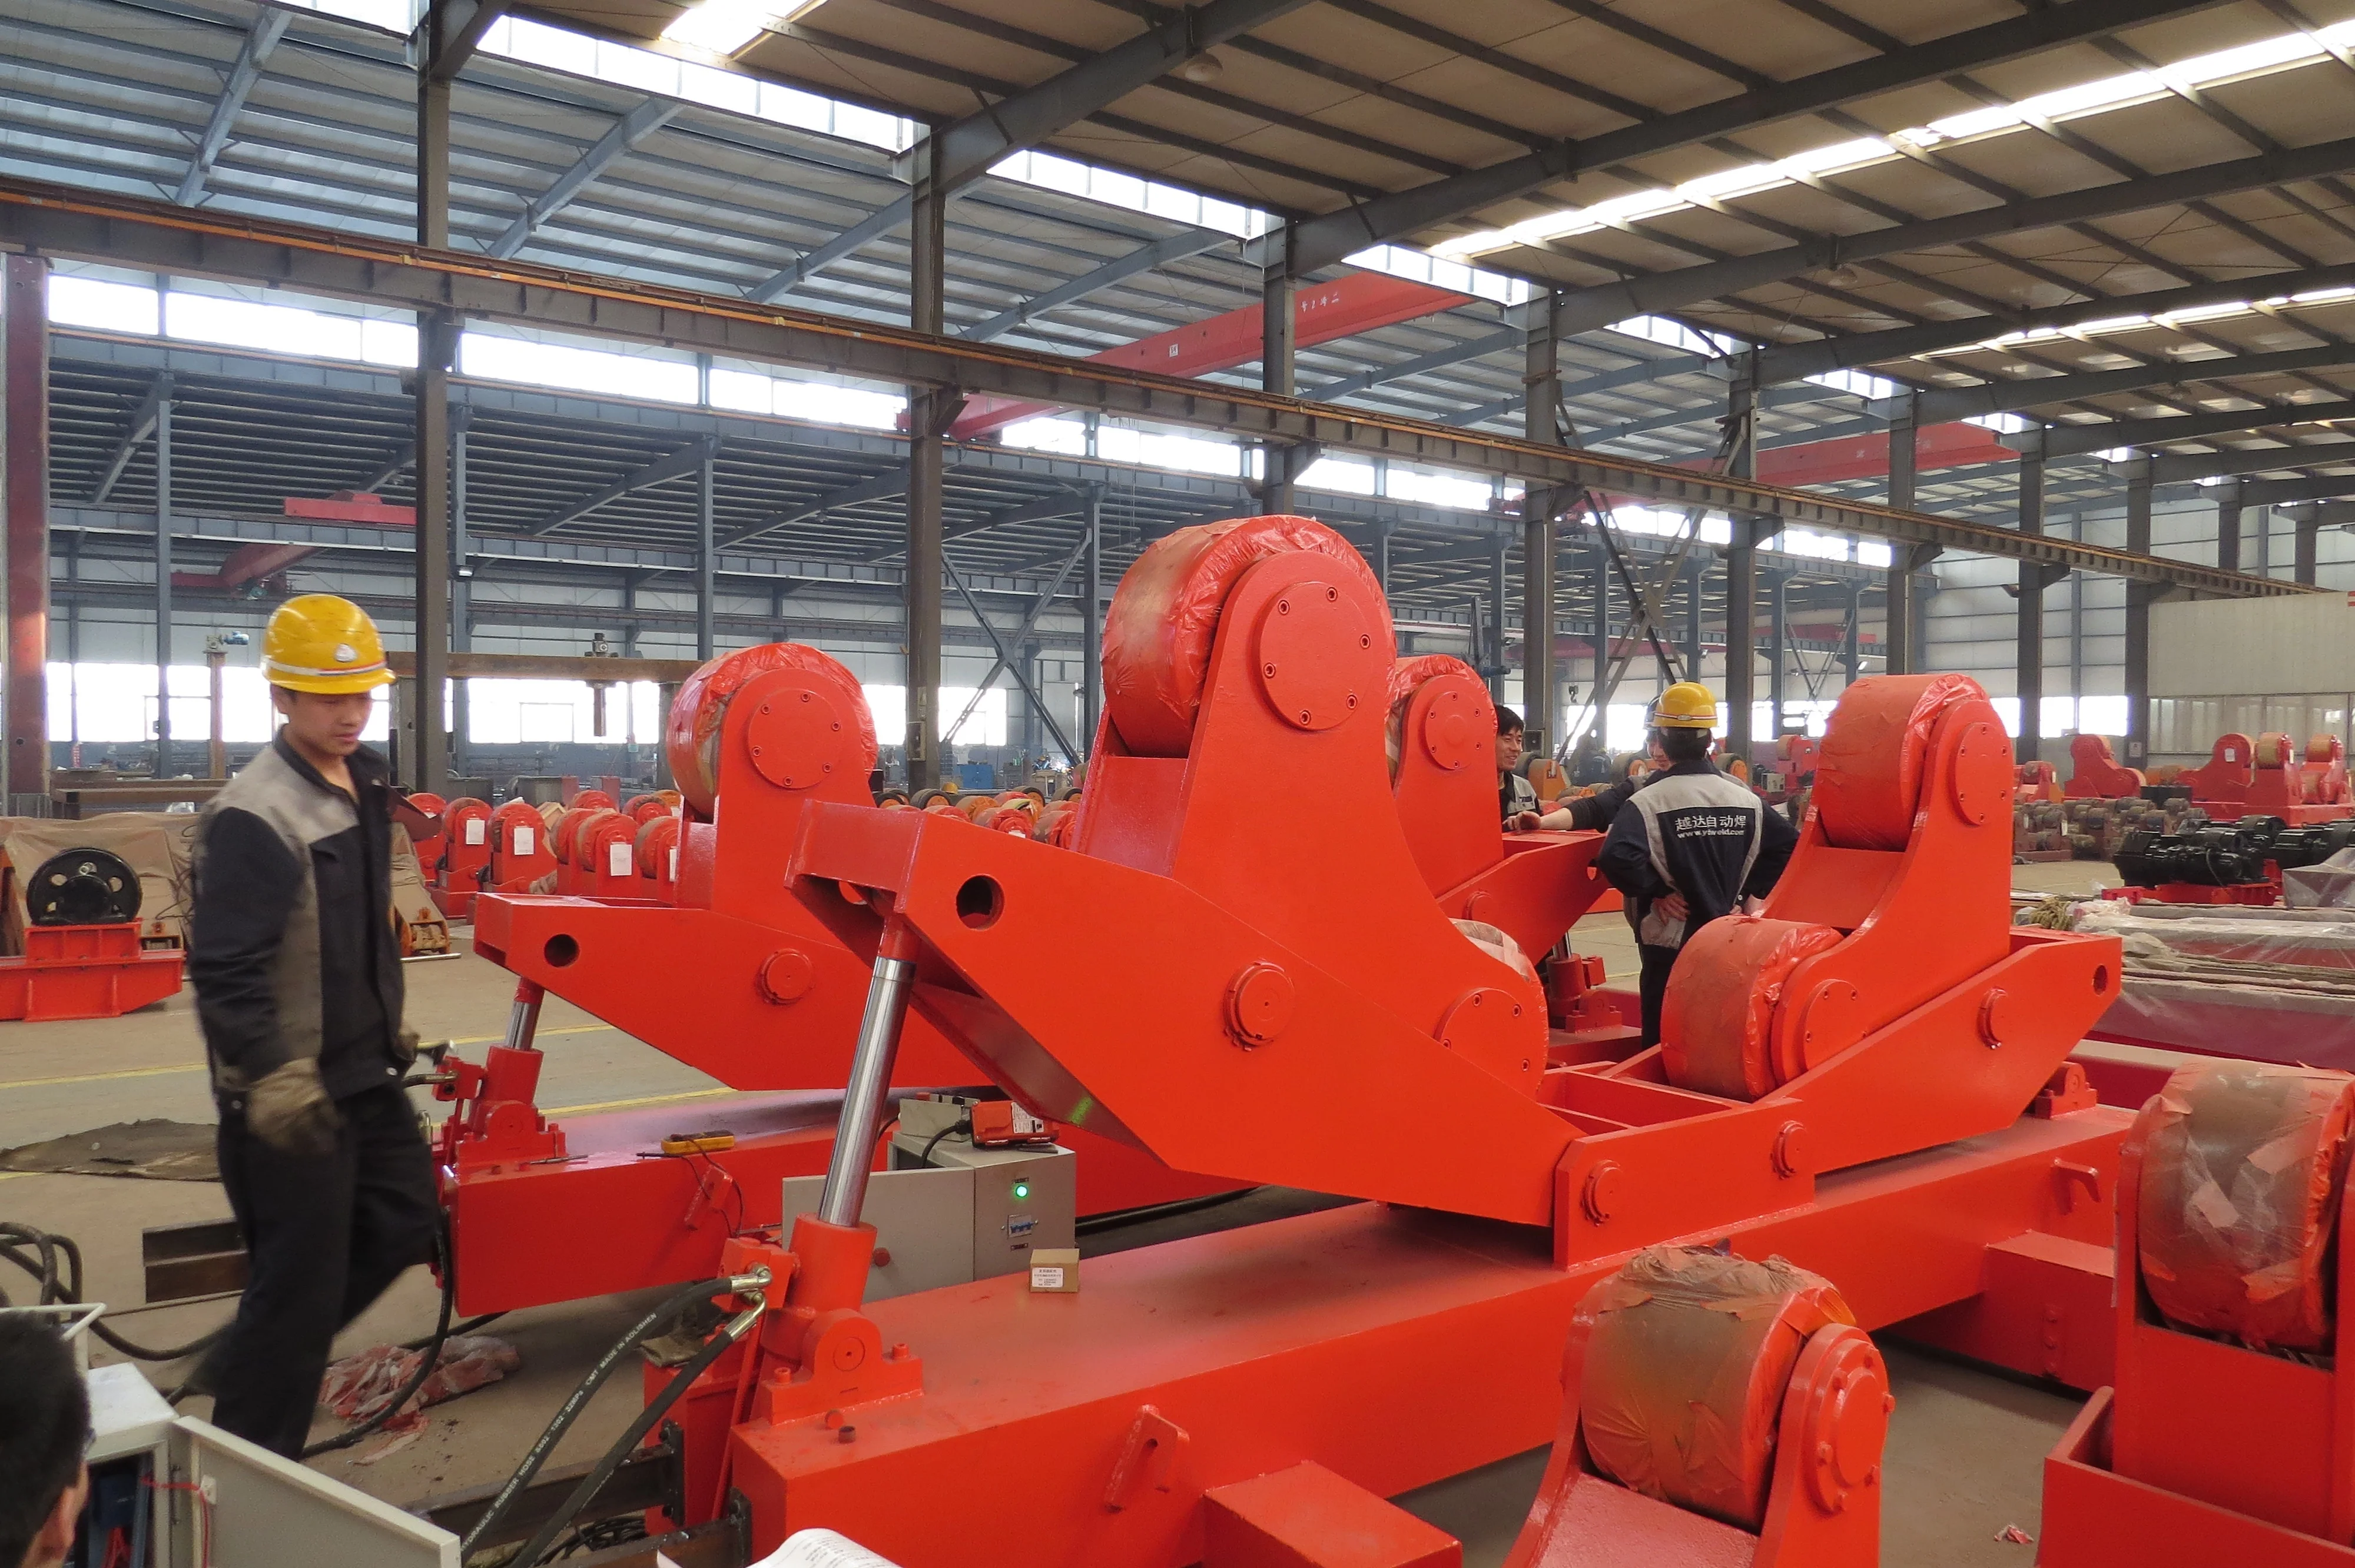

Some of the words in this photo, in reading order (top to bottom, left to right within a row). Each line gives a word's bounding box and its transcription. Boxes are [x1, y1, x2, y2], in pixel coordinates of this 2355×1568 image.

[1674, 815, 1747, 831] 越达自动焊
[494, 1477, 519, 1509] RUBBER
[518, 1456, 536, 1476] HOSE
[599, 1348, 618, 1369] MADE
[617, 1341, 626, 1350] IN
[625, 1313, 658, 1343] AOLISHEN
